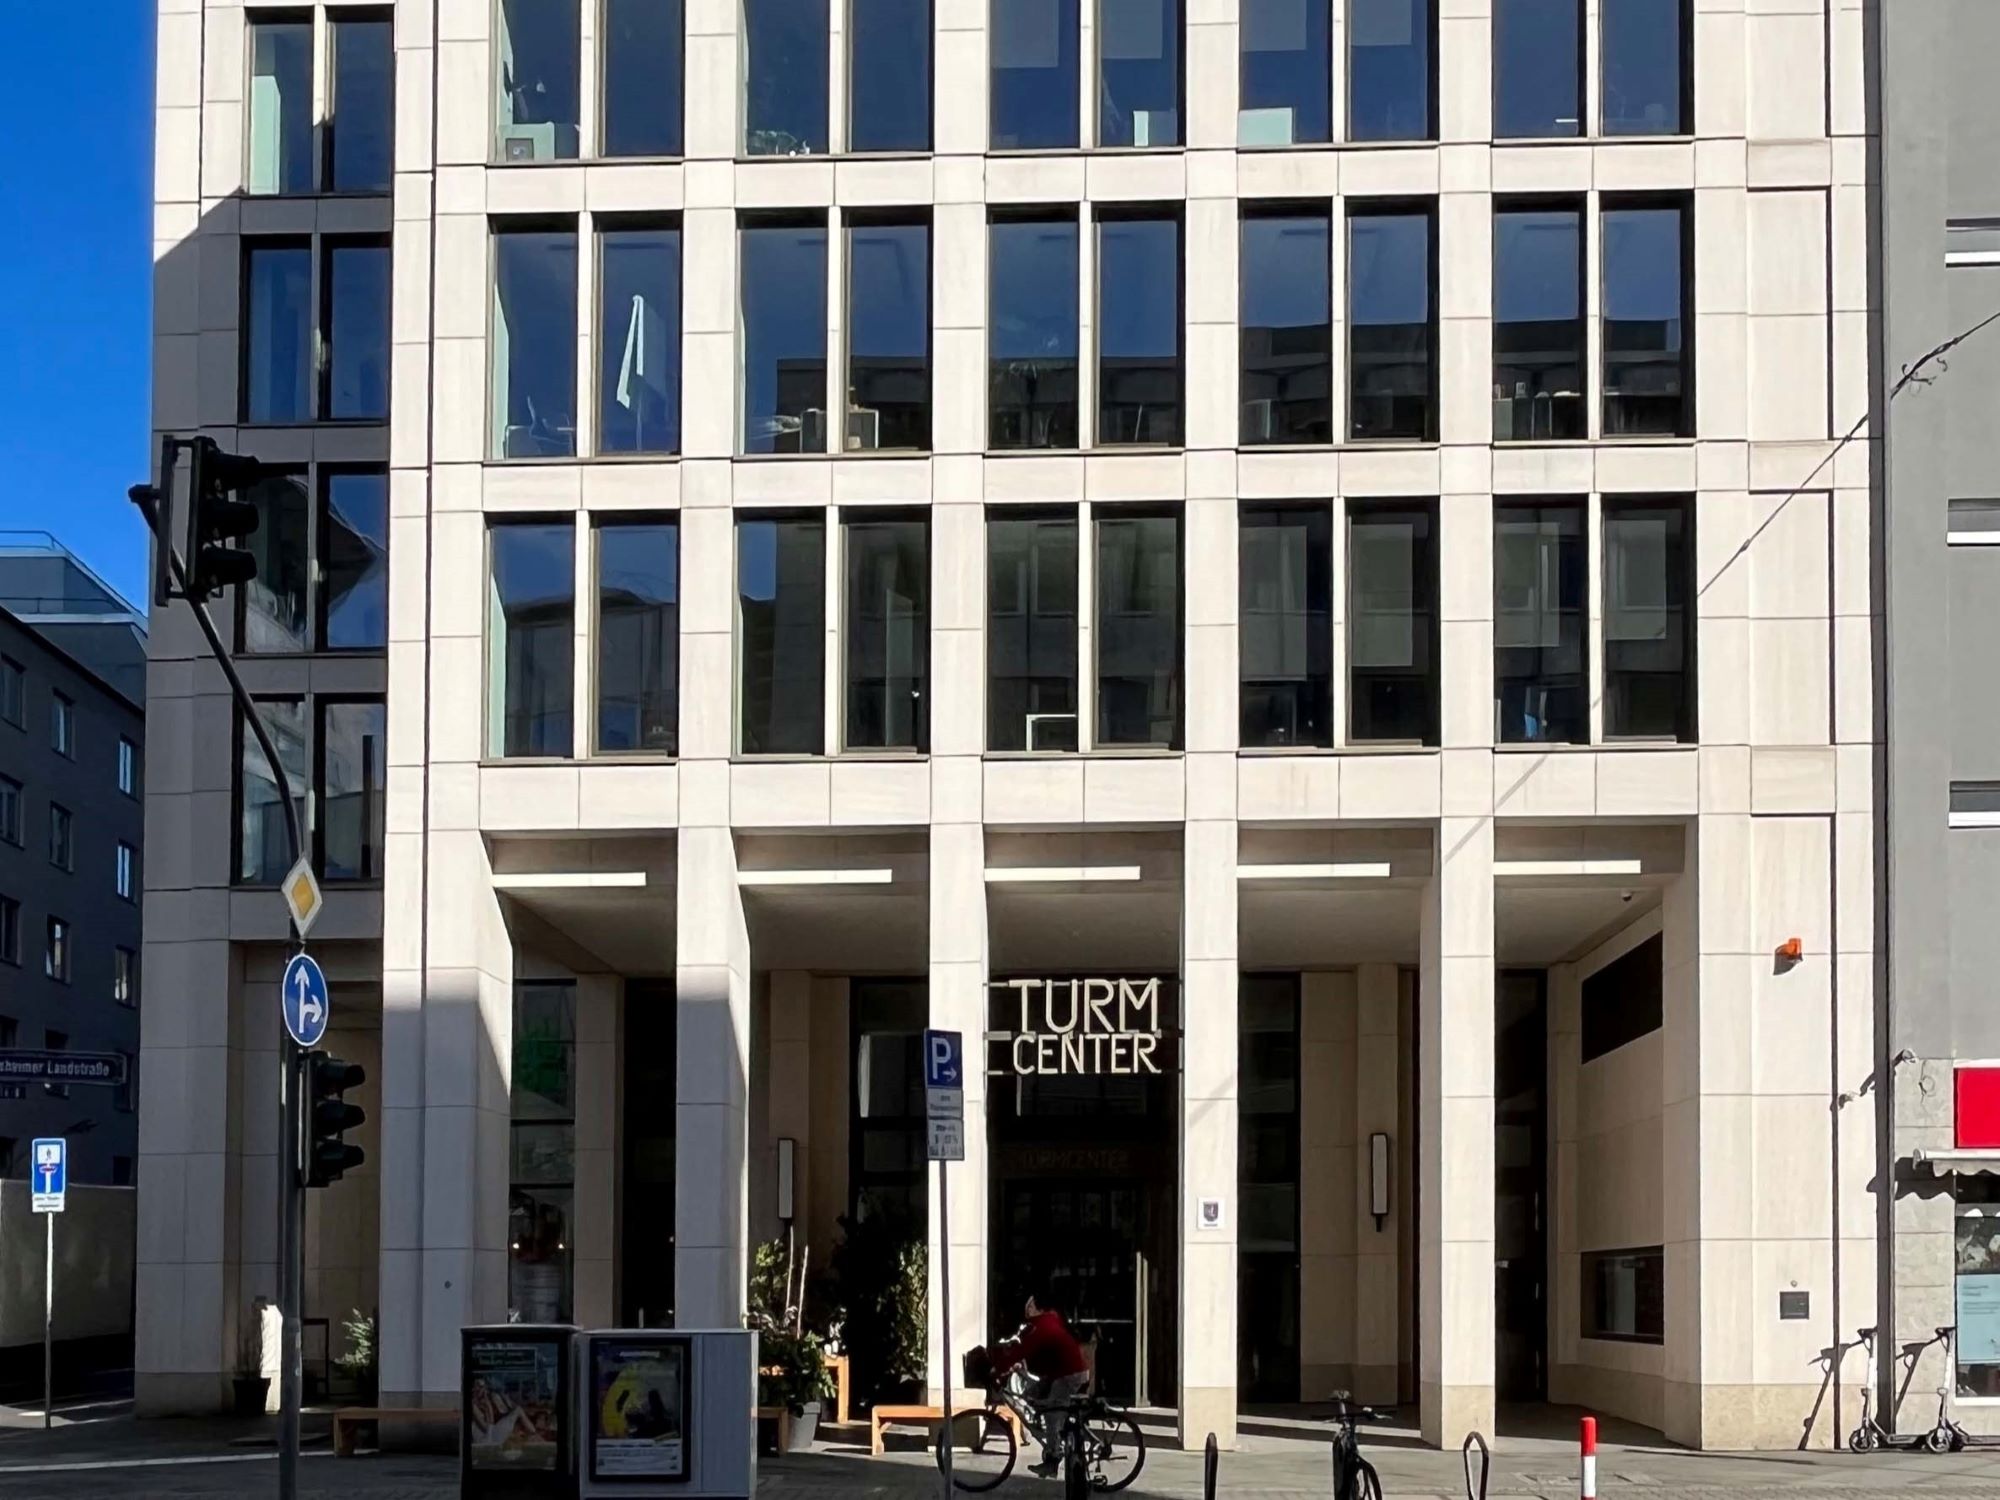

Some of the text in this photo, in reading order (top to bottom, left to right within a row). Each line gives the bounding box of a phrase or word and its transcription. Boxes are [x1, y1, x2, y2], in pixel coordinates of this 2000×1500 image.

[1009, 977, 1160, 1033] TURM
[47, 1059, 110, 1076] Landstraße
[931, 1037, 952, 1080] P
[1012, 1034, 1162, 1075] CENTER
